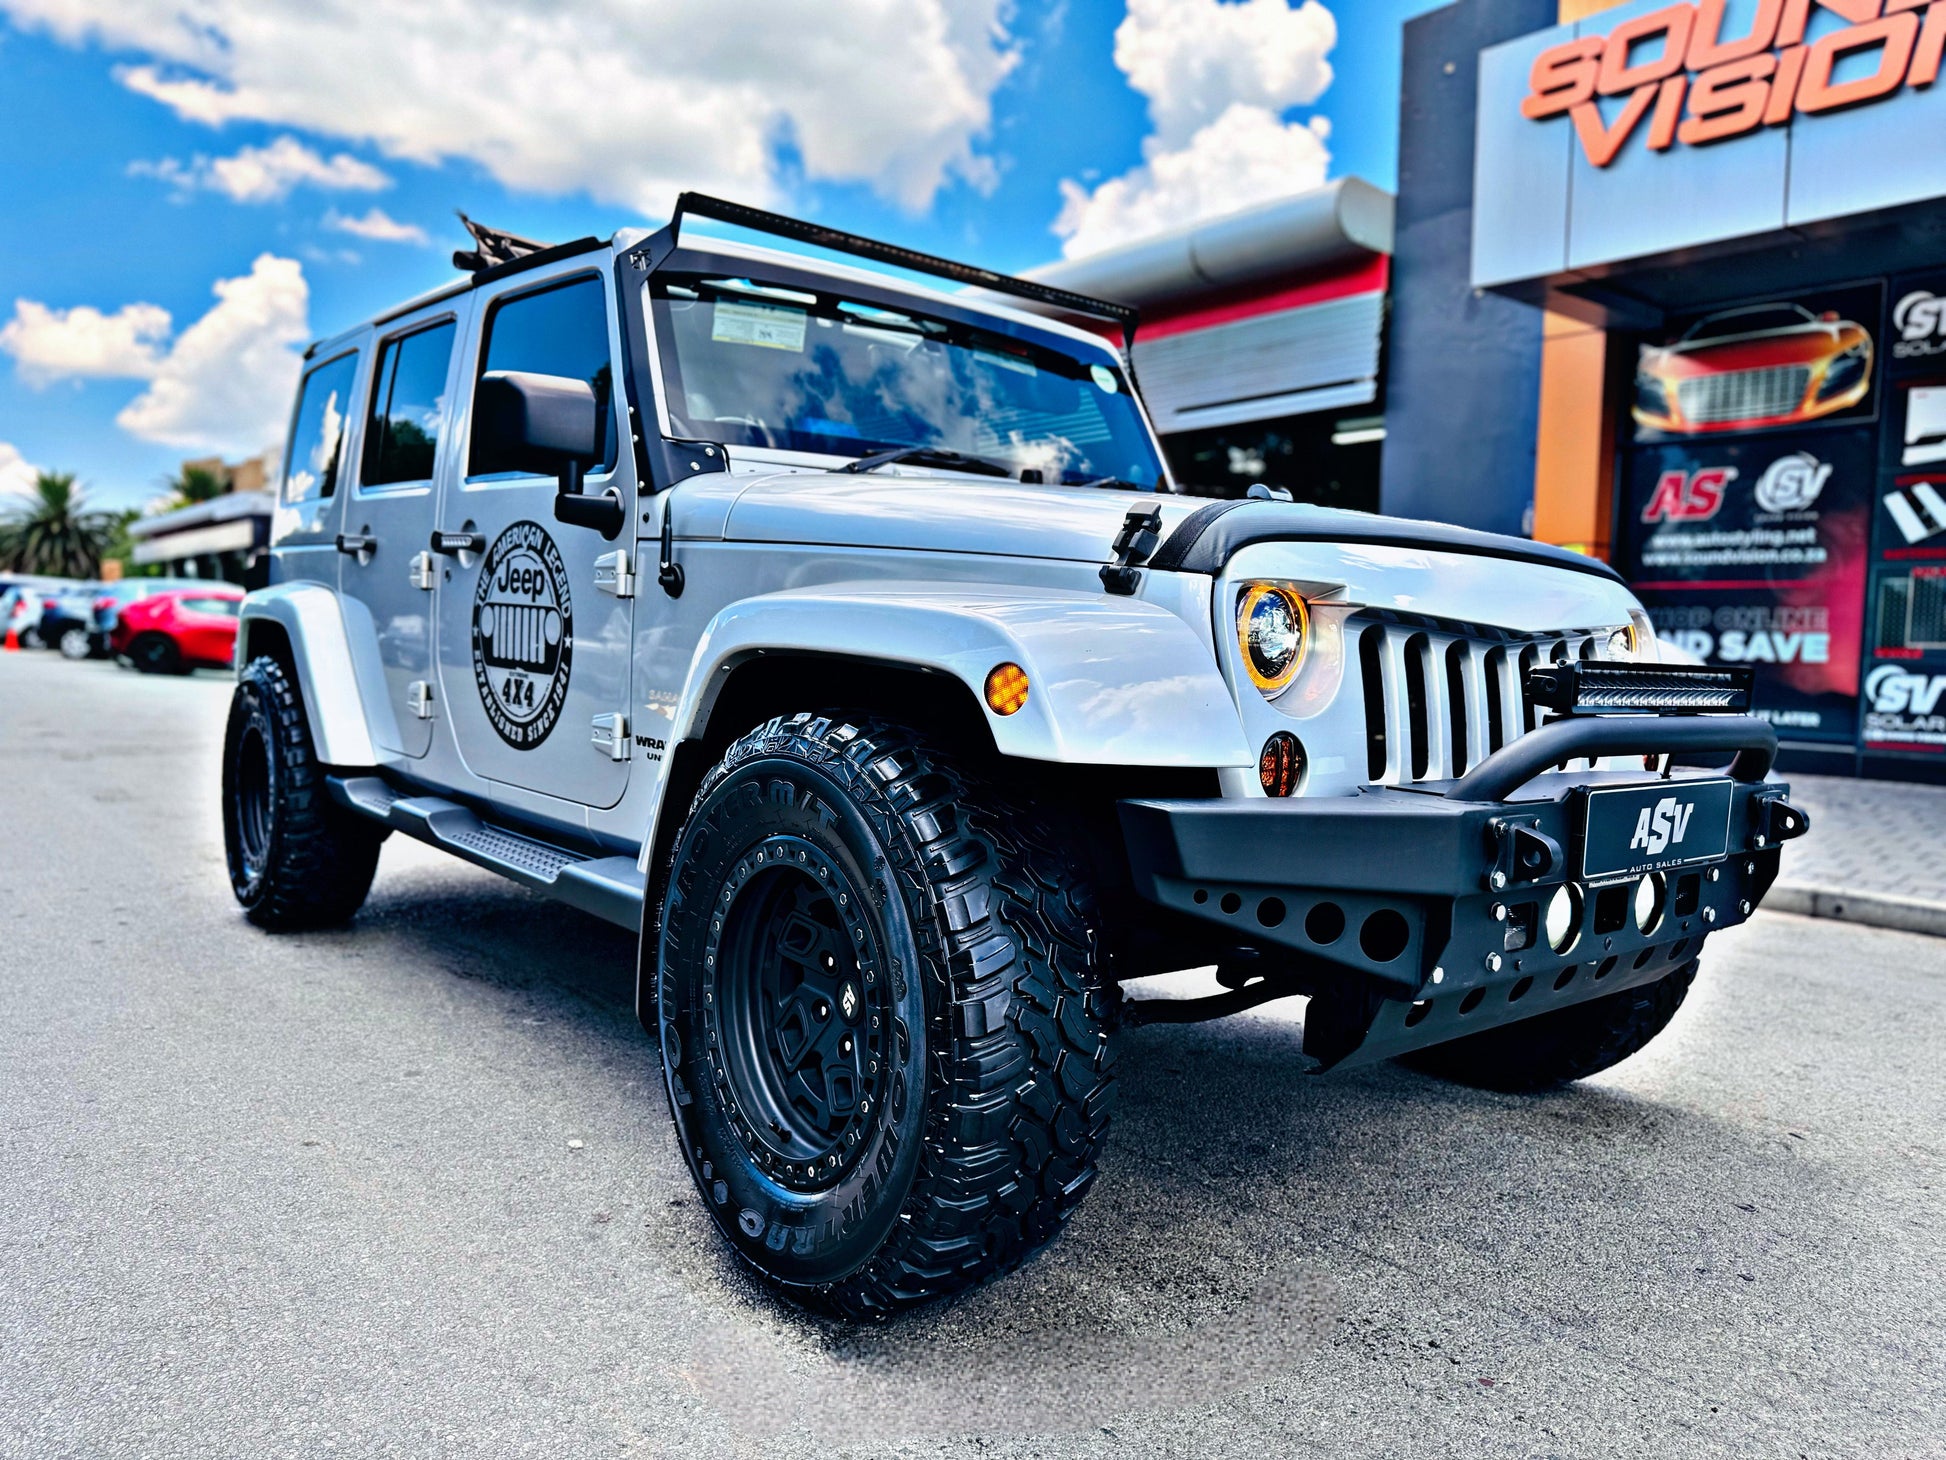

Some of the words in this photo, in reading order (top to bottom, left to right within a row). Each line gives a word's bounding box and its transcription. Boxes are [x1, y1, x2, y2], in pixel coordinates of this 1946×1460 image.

[1641, 466, 1738, 523] AS
[493, 525, 544, 569] AMERICAN
[543, 541, 572, 619] LEGEND
[498, 558, 545, 603] Jeep
[1658, 630, 1714, 664] ND
[1718, 630, 1829, 663] SAVE
[502, 678, 534, 709] 4X4
[1865, 713, 1946, 733] SOLAR
[636, 735, 667, 751] WRA
[647, 752, 662, 762] UN
[1629, 797, 1695, 855] ASV
[1629, 864, 1653, 874] AUTO
[1656, 858, 1682, 869] SALES
